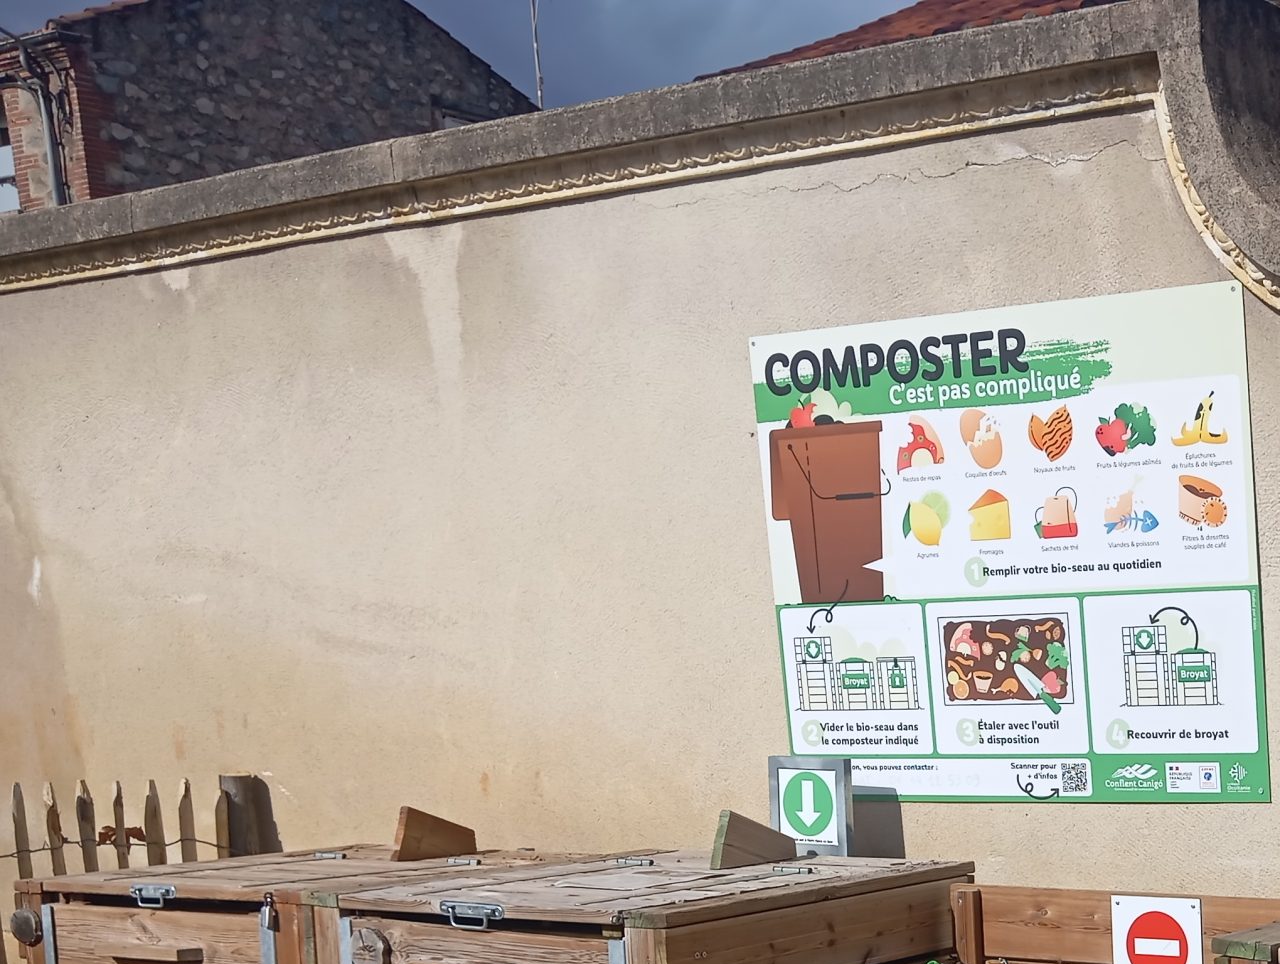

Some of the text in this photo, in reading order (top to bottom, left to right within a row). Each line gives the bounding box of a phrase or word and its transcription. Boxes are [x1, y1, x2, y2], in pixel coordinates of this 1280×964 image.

[765, 328, 1029, 396] COMPOSTER
[889, 366, 1081, 407] C'est pas compliqué
[1209, 459, 1233, 468] légumes
[983, 565, 1021, 578] Remplir
[1023, 566, 1049, 575] votre
[1051, 562, 1095, 574] bio-seau
[1098, 563, 1110, 571] au
[1113, 559, 1162, 573] quotidien
[1180, 669, 1209, 681] Broyat
[844, 676, 869, 689] Broyat
[820, 722, 843, 732] Vider
[846, 722, 855, 732] le
[856, 721, 895, 732] bio-seau
[897, 721, 919, 732] dans
[978, 718, 1005, 731] Étaler
[1008, 722, 1029, 731] avec
[1031, 720, 1060, 731] l'outil
[821, 734, 919, 748] le composteur indiqué
[979, 734, 1040, 746] à disposition
[1127, 729, 1176, 739] Recouvrir
[1179, 729, 1192, 739] de
[1194, 729, 1229, 741] broyat
[1010, 762, 1057, 772] Scanner pour
[1034, 772, 1058, 780] d'infos
[1105, 779, 1137, 788] Conflent
[1138, 779, 1163, 790] Canigó
